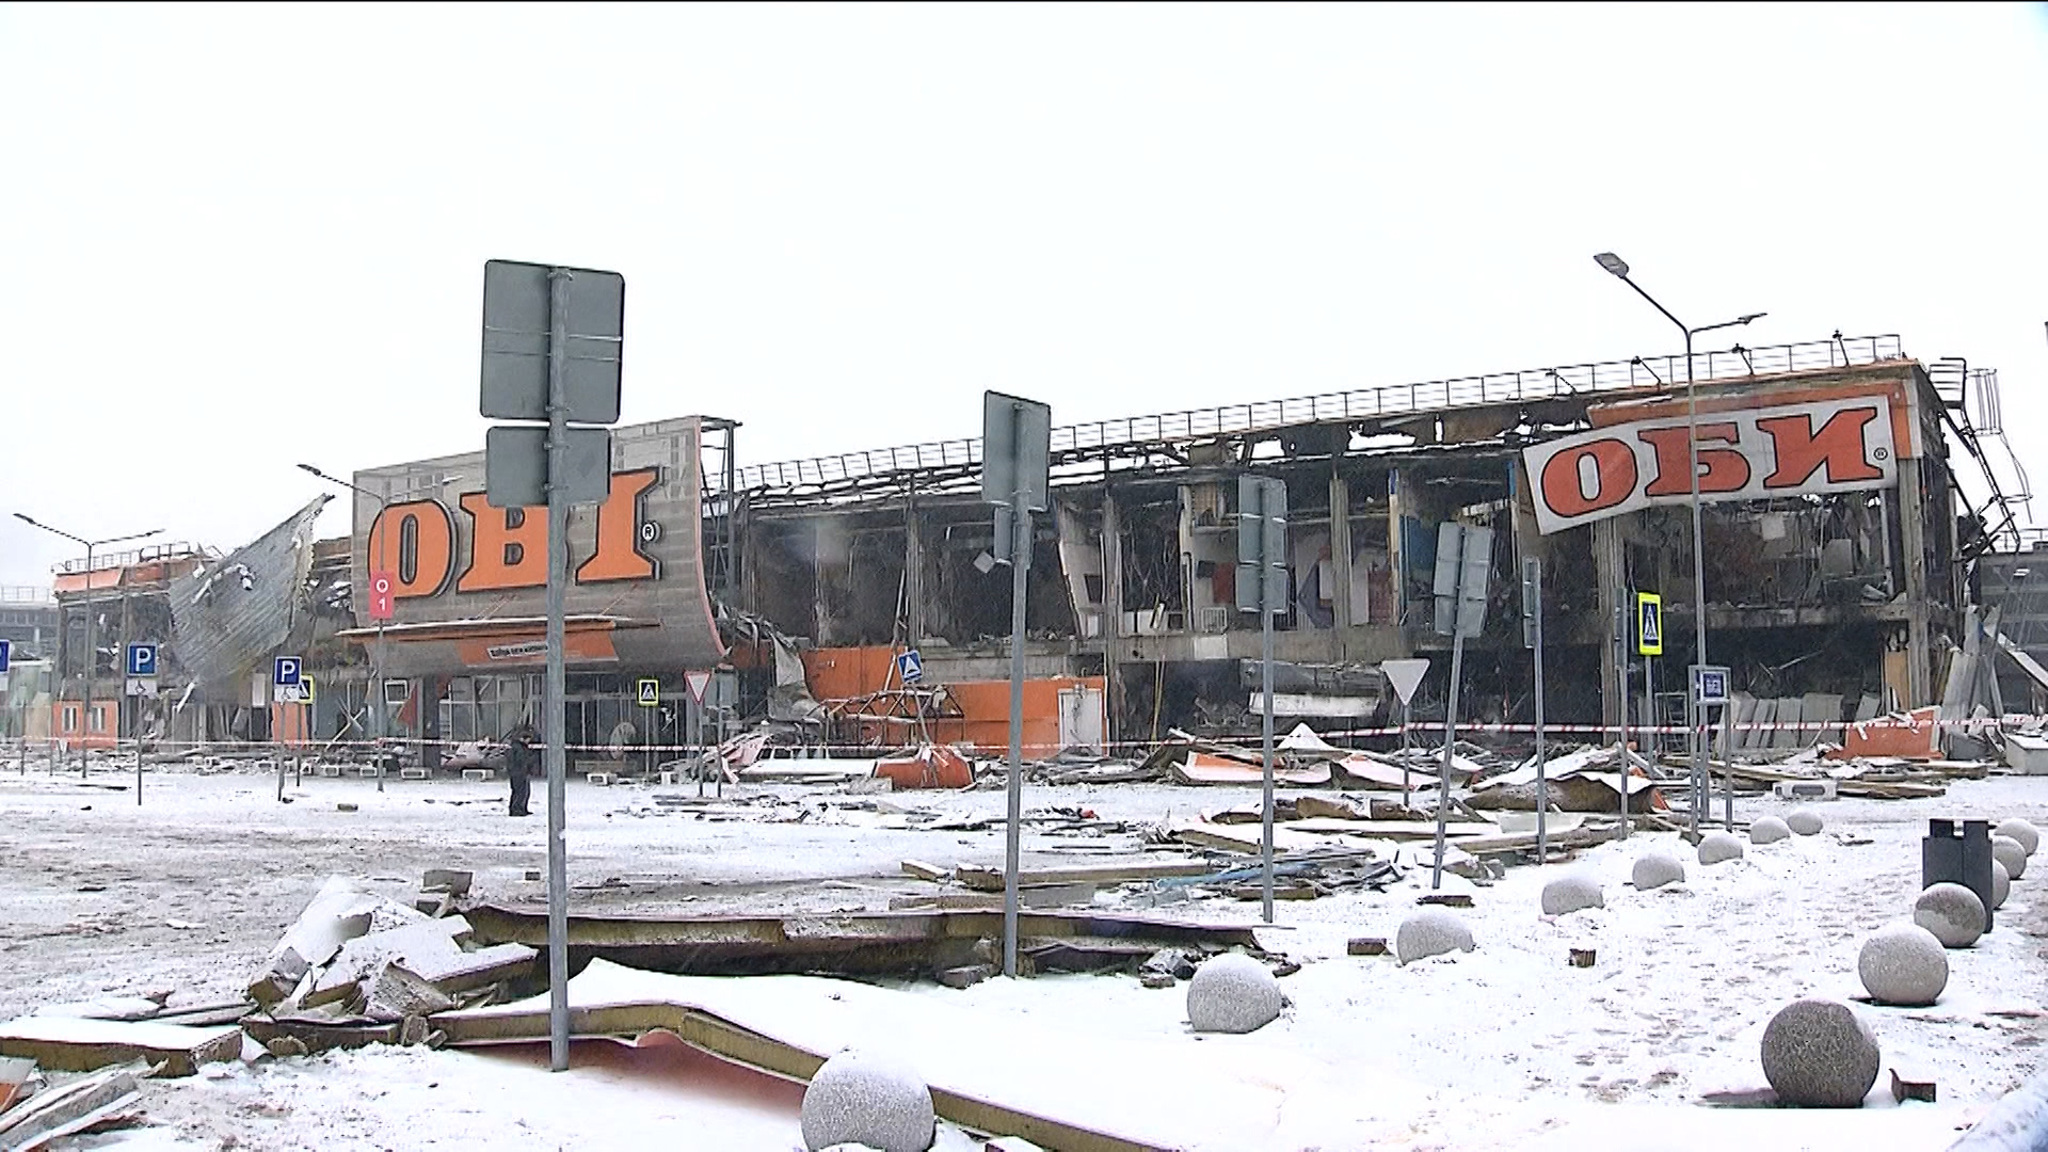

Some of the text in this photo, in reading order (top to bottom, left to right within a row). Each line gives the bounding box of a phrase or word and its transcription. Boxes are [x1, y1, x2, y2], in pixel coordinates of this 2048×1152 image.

[1541, 406, 1885, 517] ОБИ
[367, 467, 661, 600] OBI
[378, 596, 386, 612] 1
[136, 647, 151, 672] P
[281, 660, 296, 687] P
